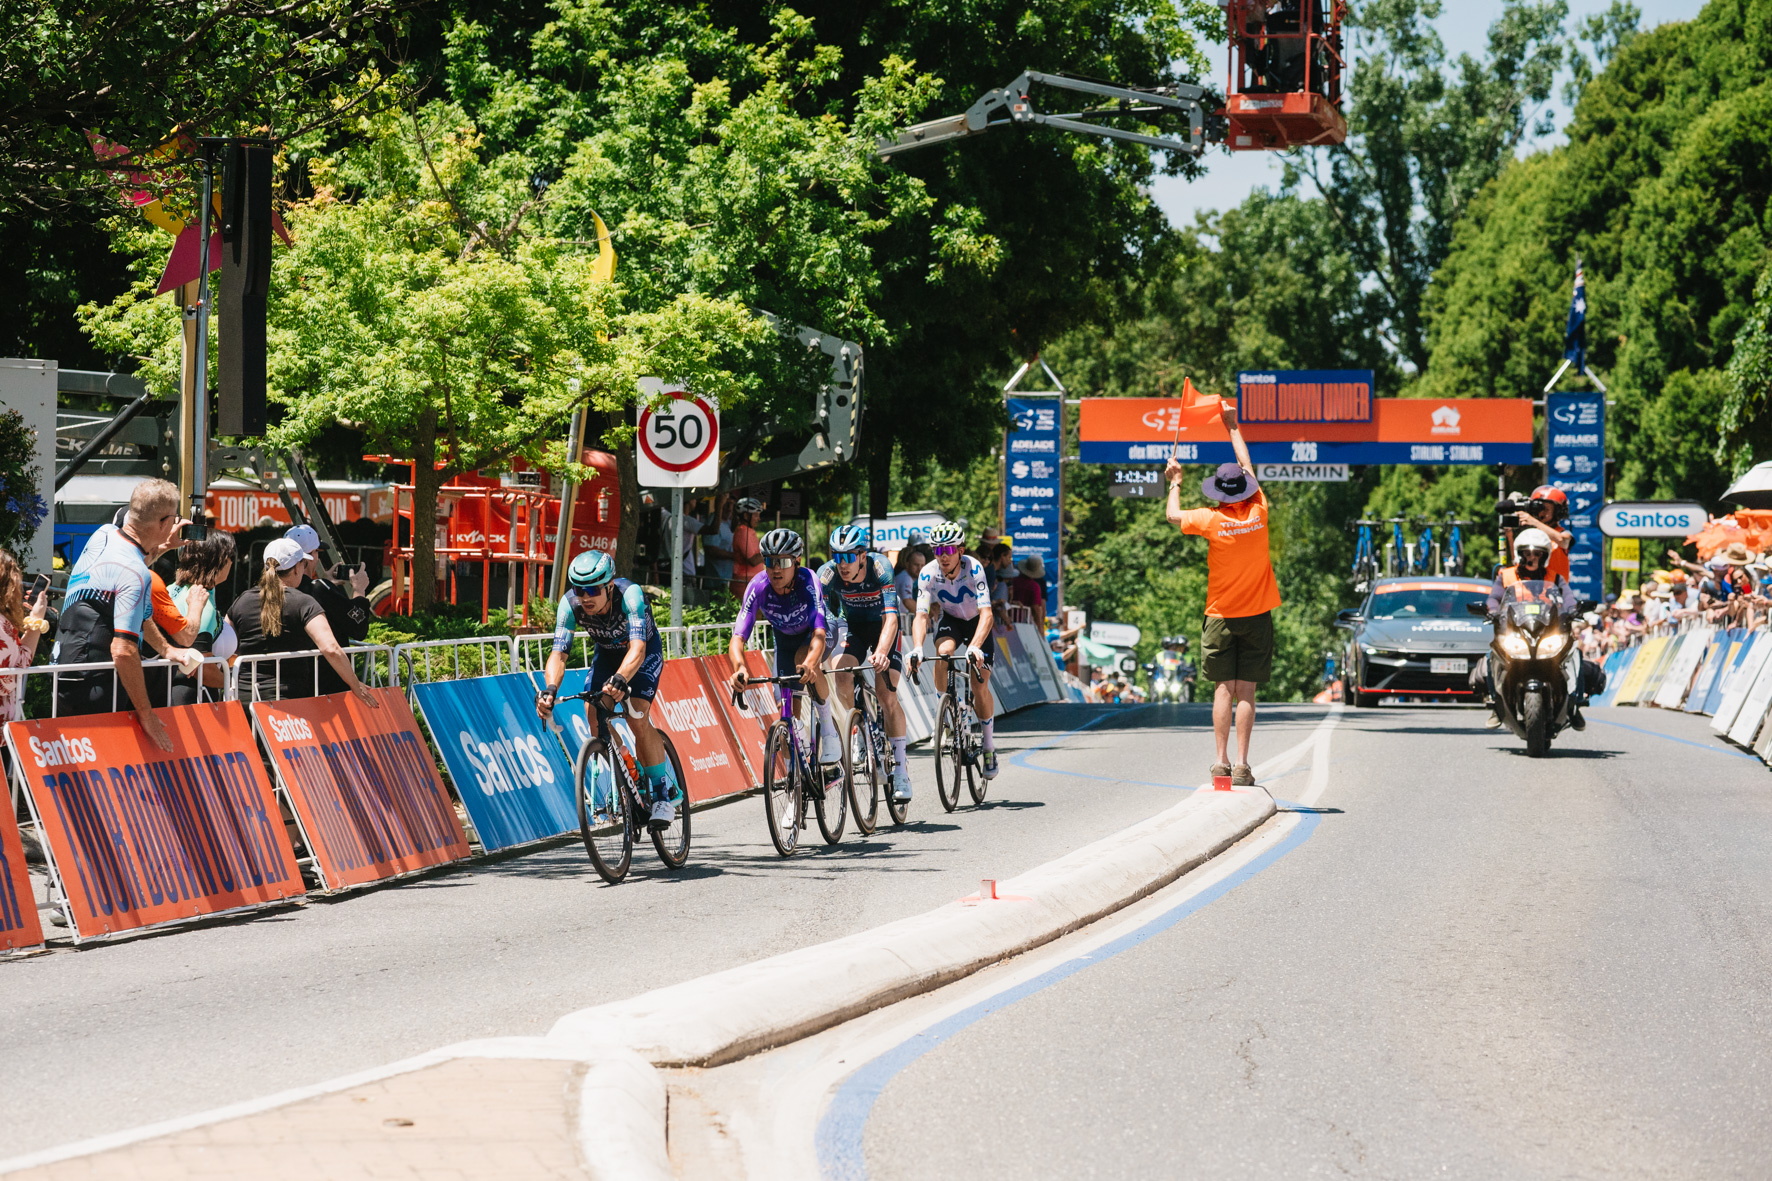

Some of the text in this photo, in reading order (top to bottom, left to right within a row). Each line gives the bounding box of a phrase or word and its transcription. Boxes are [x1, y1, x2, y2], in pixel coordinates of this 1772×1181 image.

[1240, 374, 1276, 384] Santos
[1240, 382, 1370, 421] TOUR DOWN UNDER
[654, 414, 703, 450] 50
[1012, 440, 1055, 449] ADELAIDE
[1292, 442, 1318, 462] 2026
[1264, 466, 1343, 478] GARMIN
[1011, 485, 1054, 498] Santos
[218, 496, 260, 527] TOUR
[1616, 512, 1690, 528] Santos
[1218, 523, 1264, 536] MARSHAL
[1220, 516, 1261, 528] TRAFFIC
[580, 536, 608, 550] SJ46
[655, 684, 718, 744] Vanguard
[268, 714, 312, 743] Santos
[28, 734, 96, 768] Santos
[460, 726, 554, 796] Santos
[42, 770, 148, 918] TOUR
[108, 760, 219, 906] DOWN
[179, 751, 290, 892] UNDER
